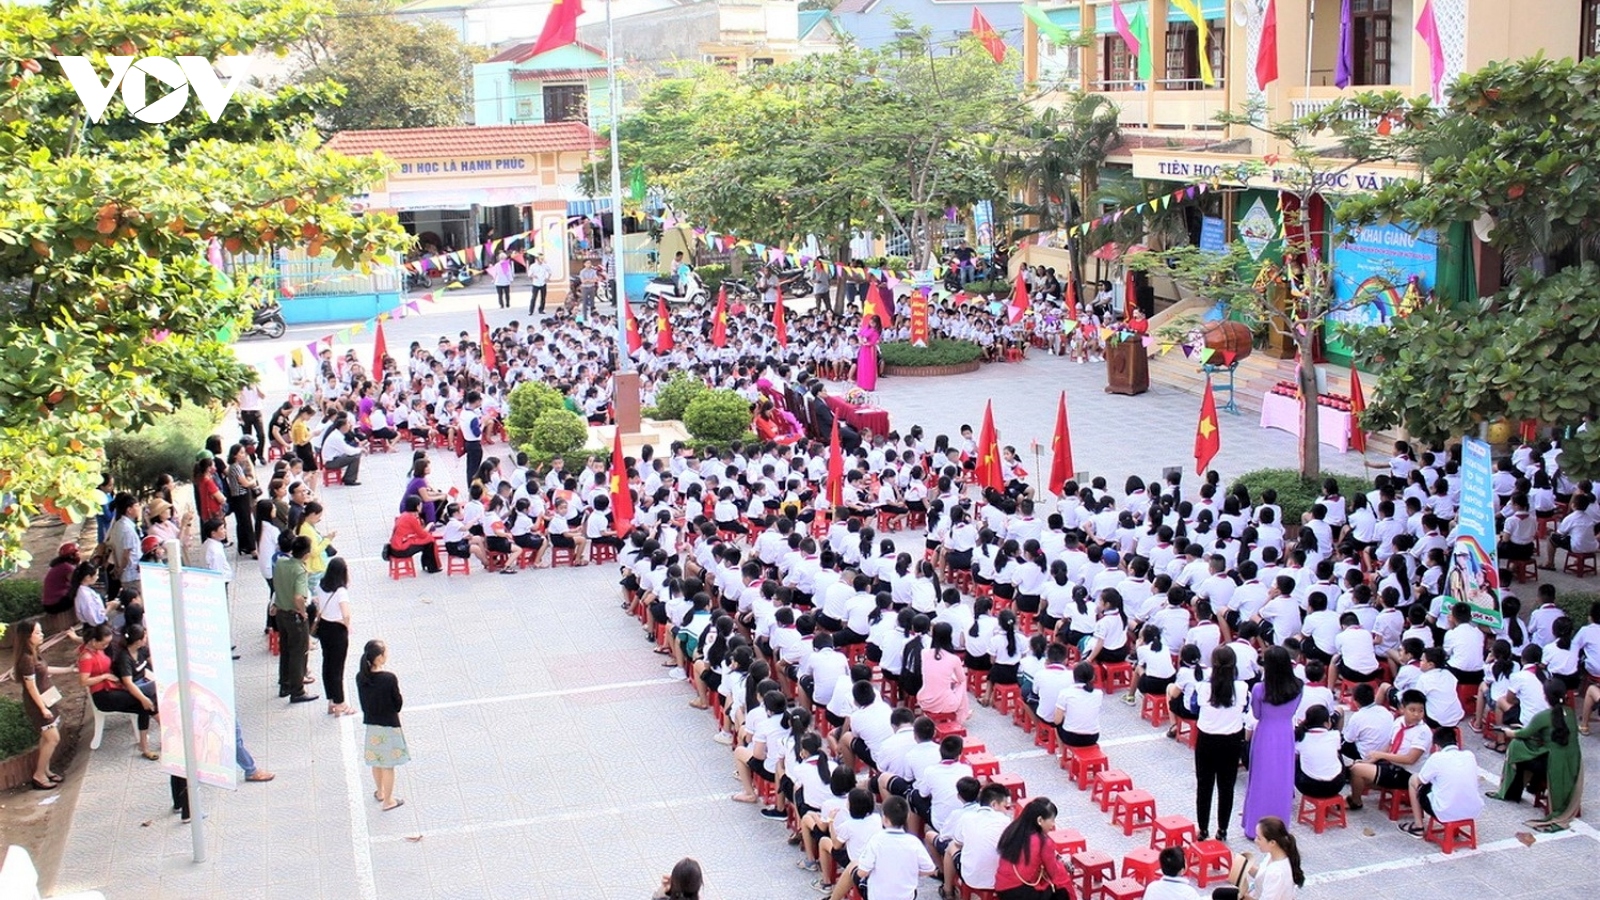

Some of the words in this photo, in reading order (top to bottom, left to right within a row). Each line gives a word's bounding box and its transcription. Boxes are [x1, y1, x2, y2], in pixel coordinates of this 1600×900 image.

[417, 162, 439, 176] HỌC
[443, 159, 457, 172] LÀ
[461, 159, 492, 174] HẠNH
[495, 158, 525, 170] PHÚC
[1157, 159, 1190, 176] TIÊN
[1360, 228, 1382, 244] KHAI
